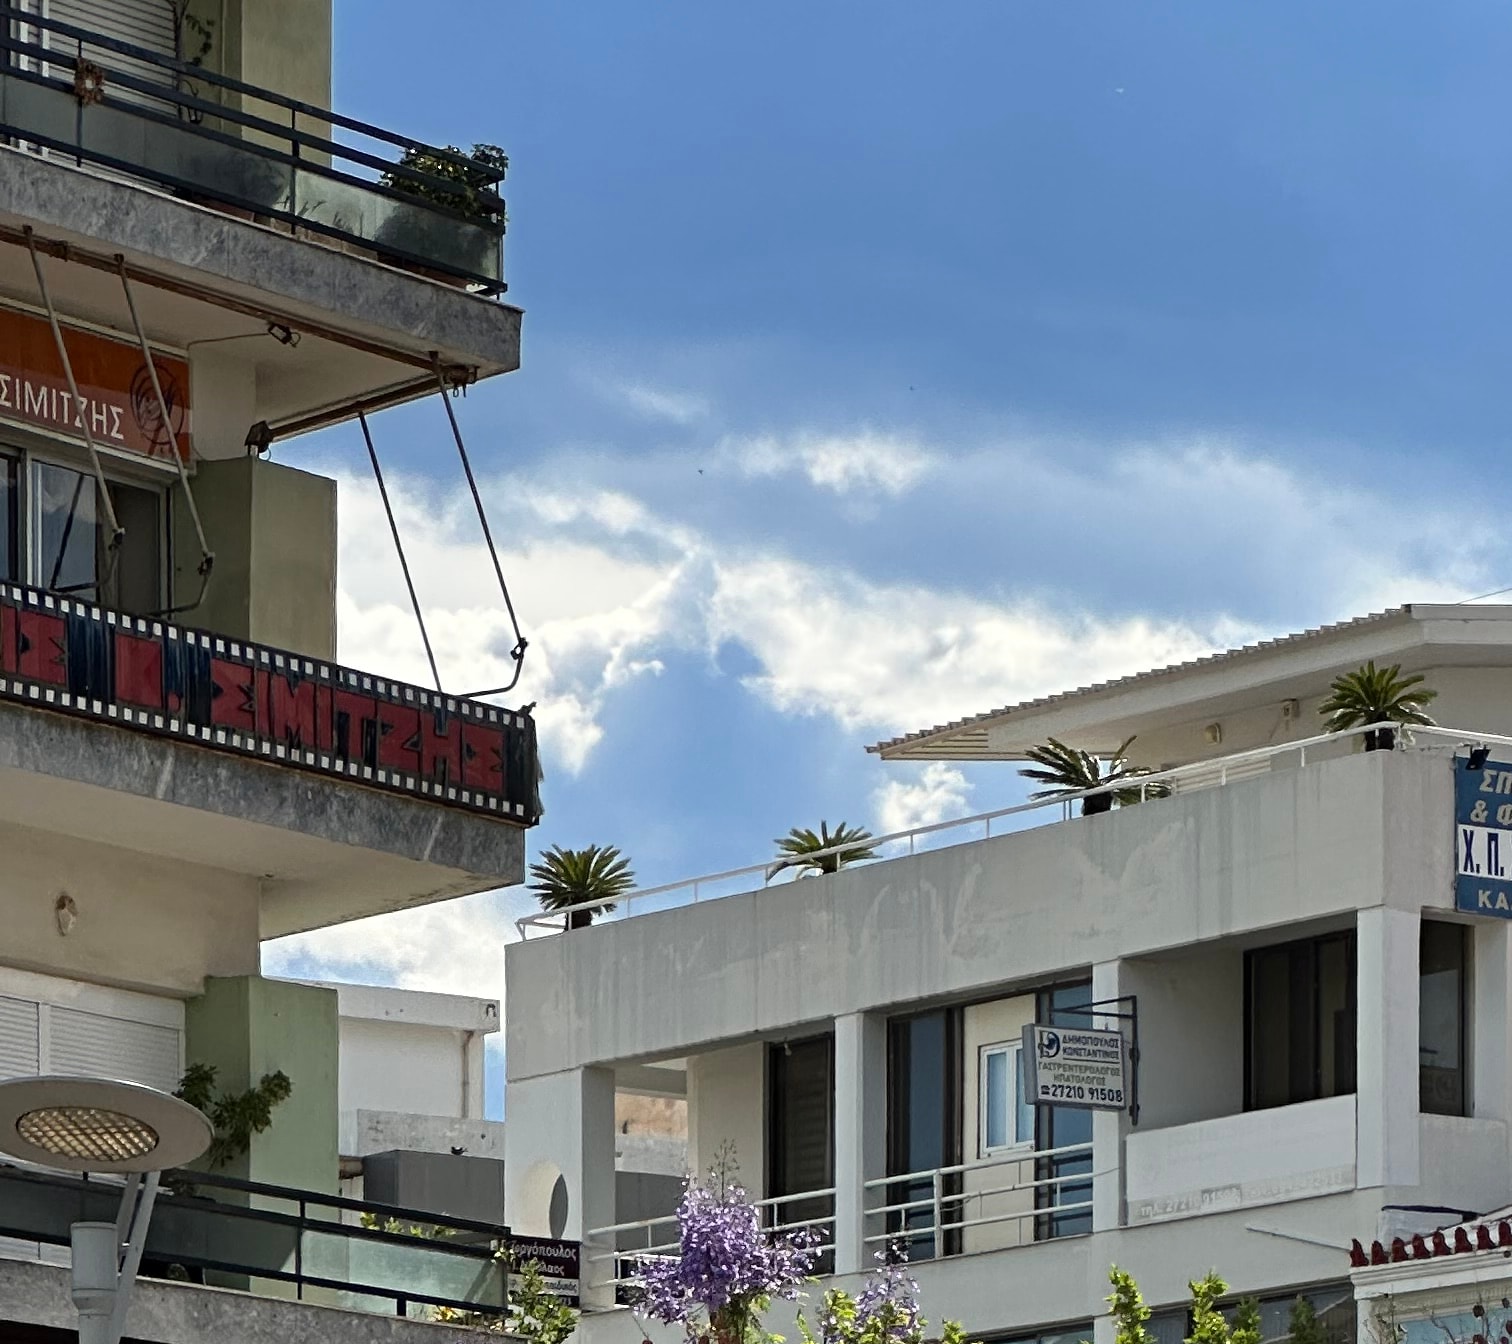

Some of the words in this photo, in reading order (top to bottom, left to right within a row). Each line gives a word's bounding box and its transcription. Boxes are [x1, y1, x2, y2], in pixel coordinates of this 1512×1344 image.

[210, 656, 506, 792] ΣΙΜΙΤΖΗΣ
[1470, 800, 1489, 823] &
[1462, 828, 1480, 874] Χ.
[1487, 832, 1504, 877] Π.
[1051, 1084, 1084, 1100] 27210
